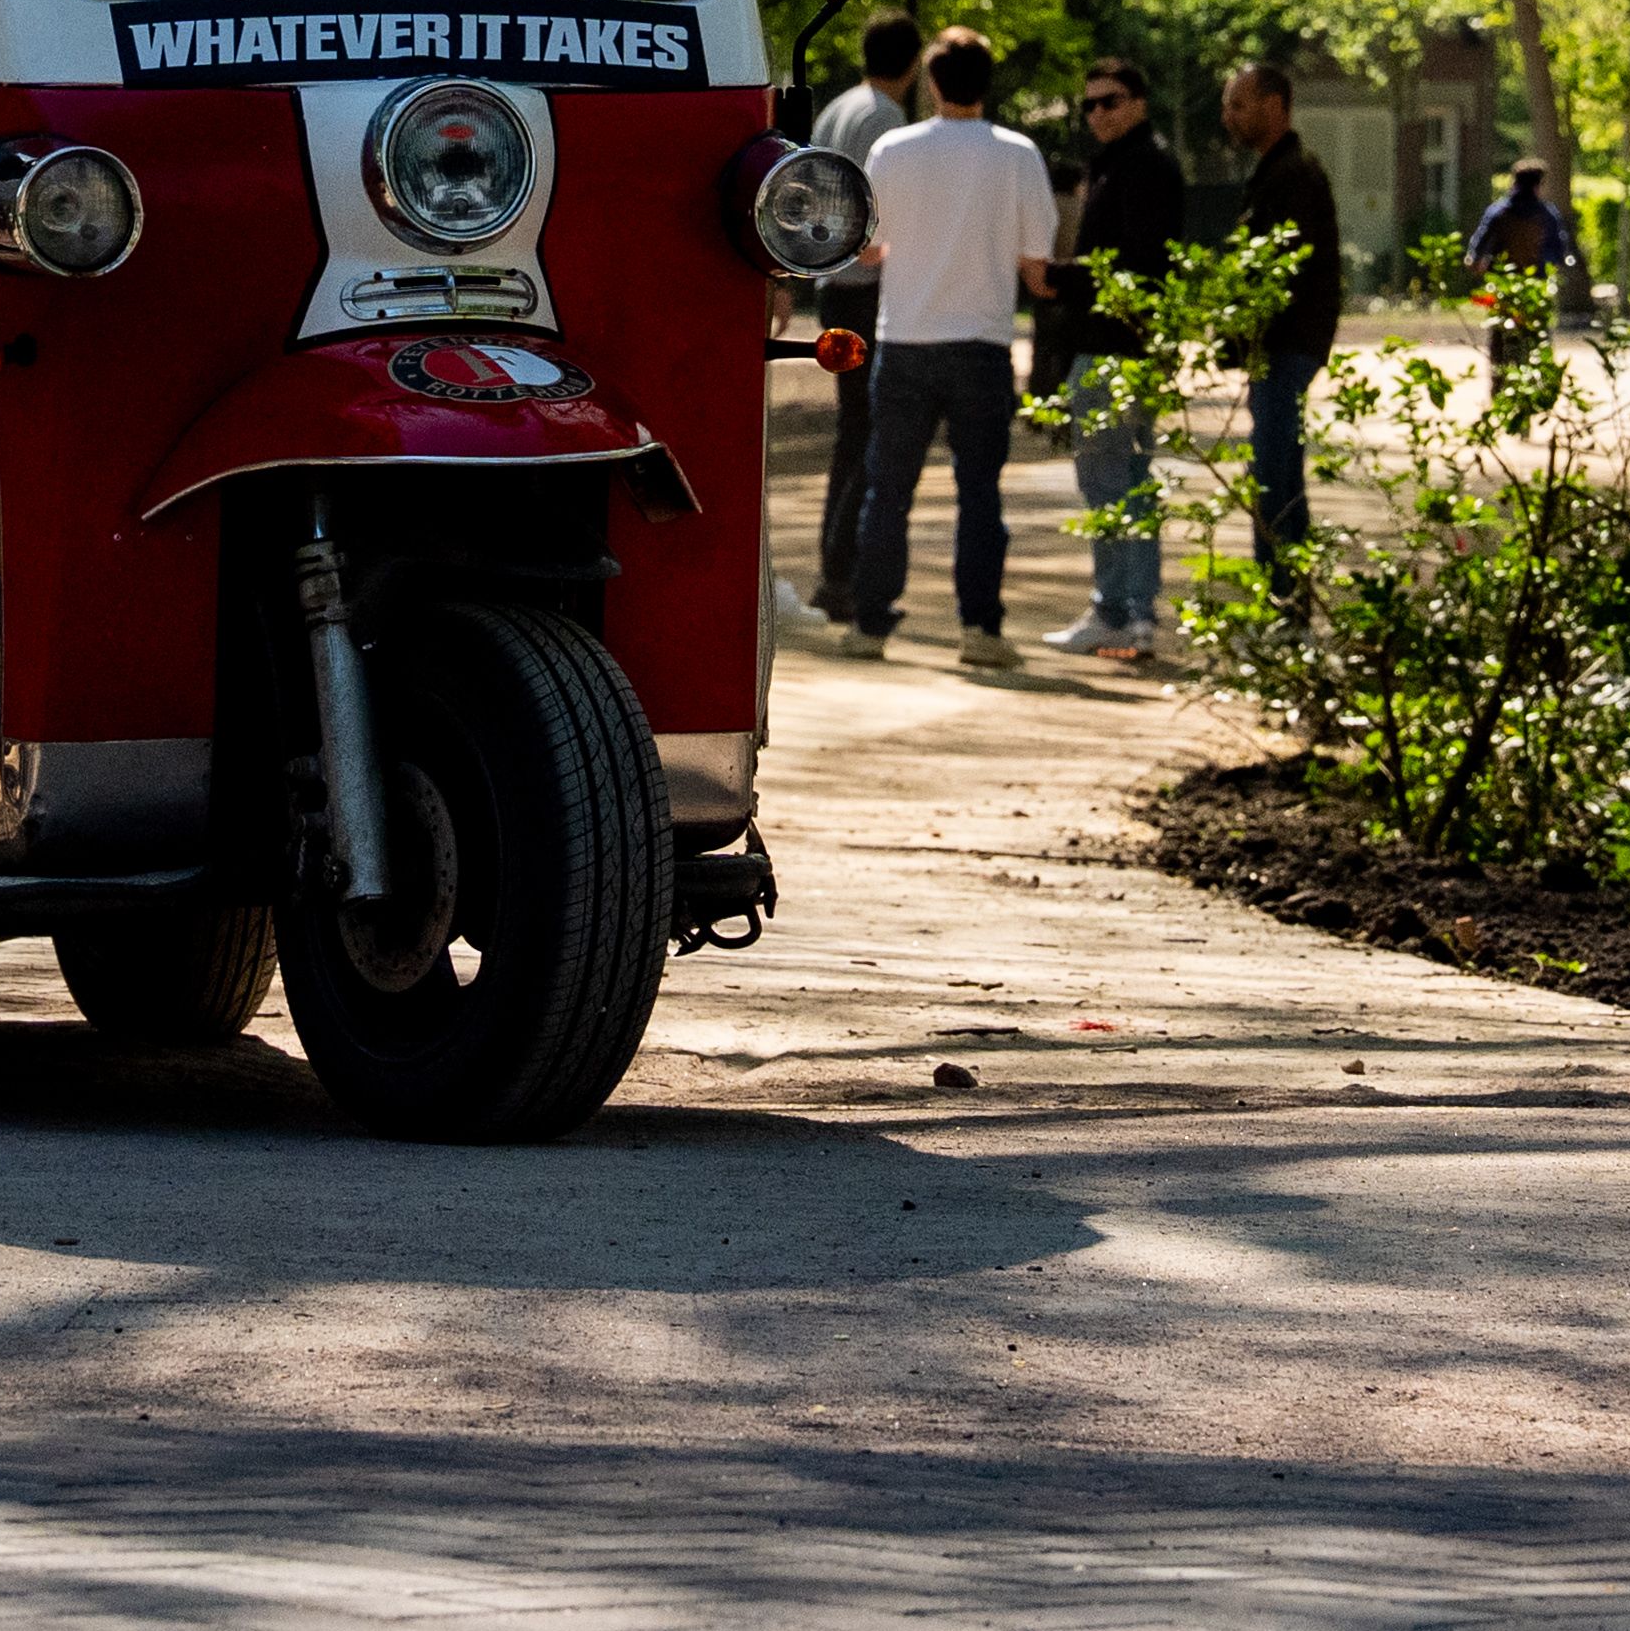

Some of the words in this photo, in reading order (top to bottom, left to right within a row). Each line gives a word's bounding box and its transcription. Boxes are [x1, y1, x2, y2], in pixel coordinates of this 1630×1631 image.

[128, 13, 450, 70] WHATEVER
[459, 14, 510, 60] IT
[517, 16, 688, 70] TAKES
[425, 376, 588, 399] ROTTERDAM
